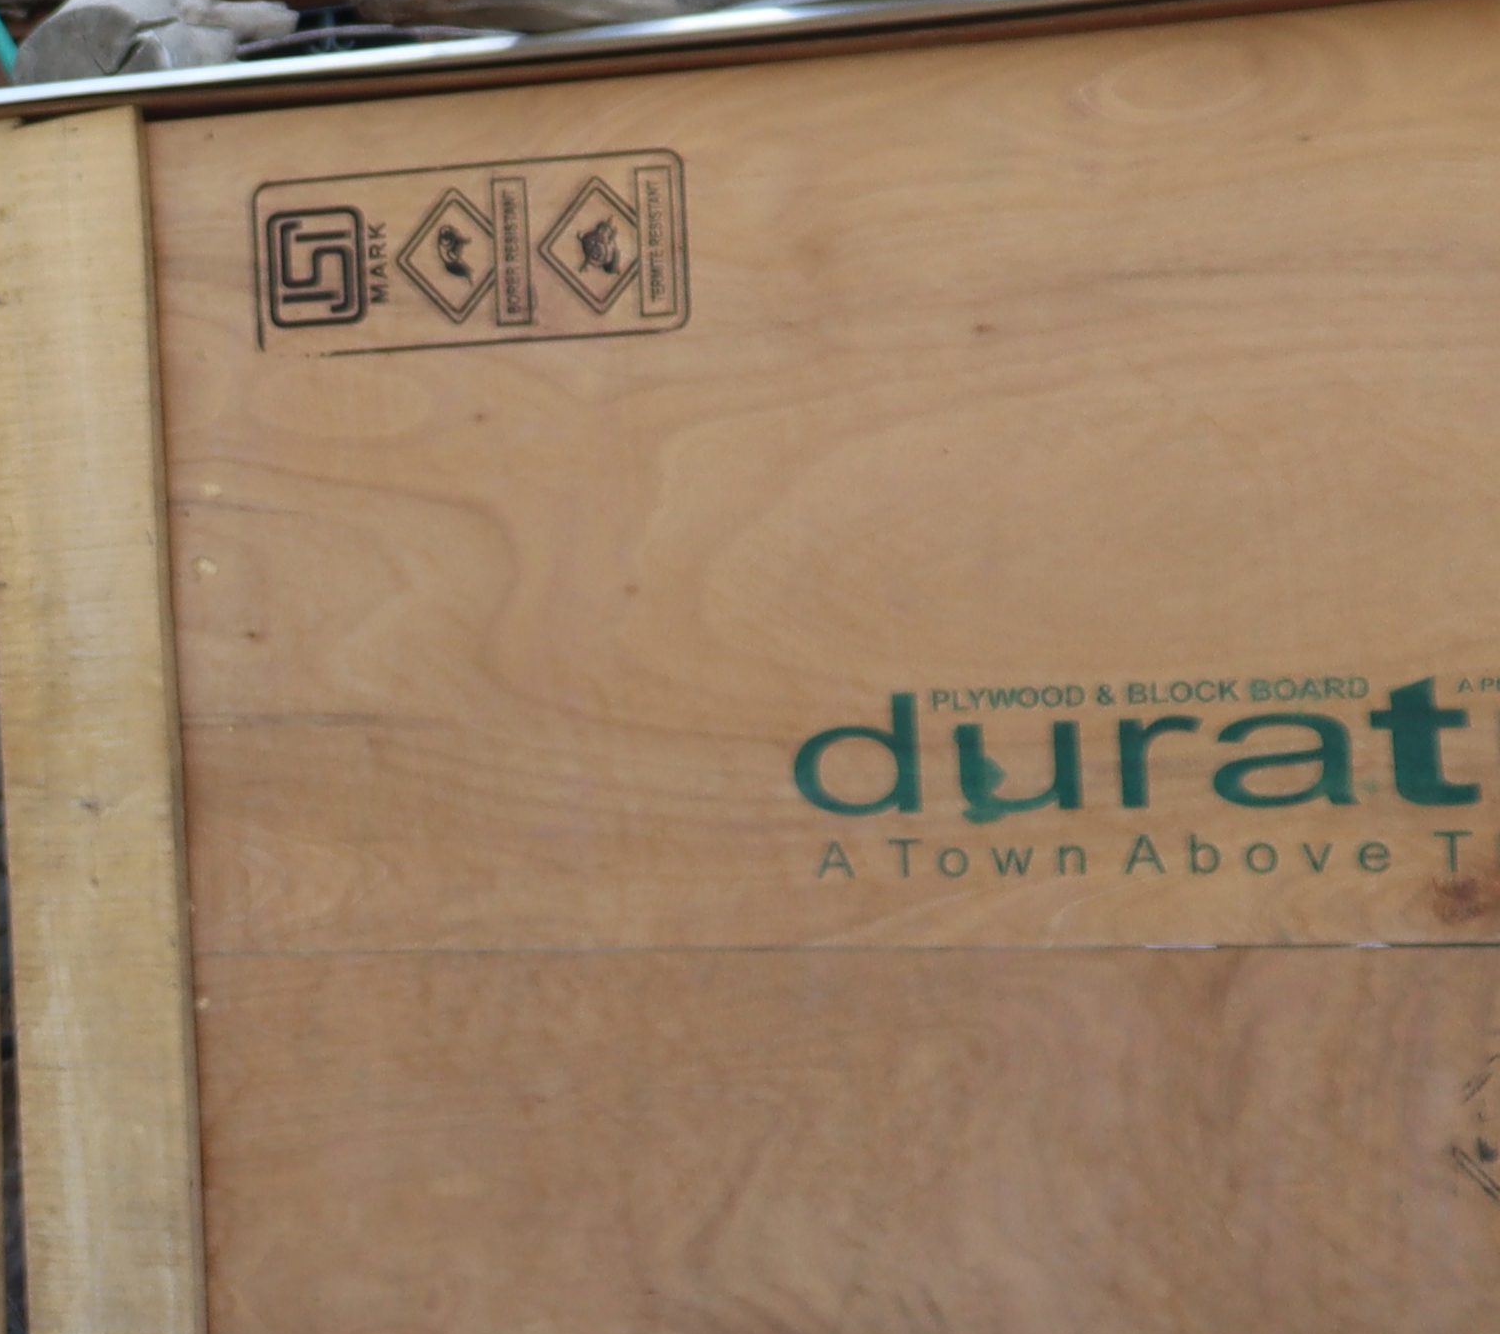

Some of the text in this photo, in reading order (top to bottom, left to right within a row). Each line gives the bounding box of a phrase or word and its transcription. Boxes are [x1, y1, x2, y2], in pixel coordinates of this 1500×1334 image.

[503, 188, 519, 261] RESISTANT
[648, 179, 668, 304] TERMITE RESISTANT
[367, 221, 388, 305] MARK
[932, 677, 1369, 711] PLYWOOD & BLOCK BOARD
[1457, 678, 1473, 693] A
[794, 677, 1500, 819] durat
[817, 840, 855, 878] A
[889, 837, 1086, 877] Town
[1124, 834, 1390, 874] Above
